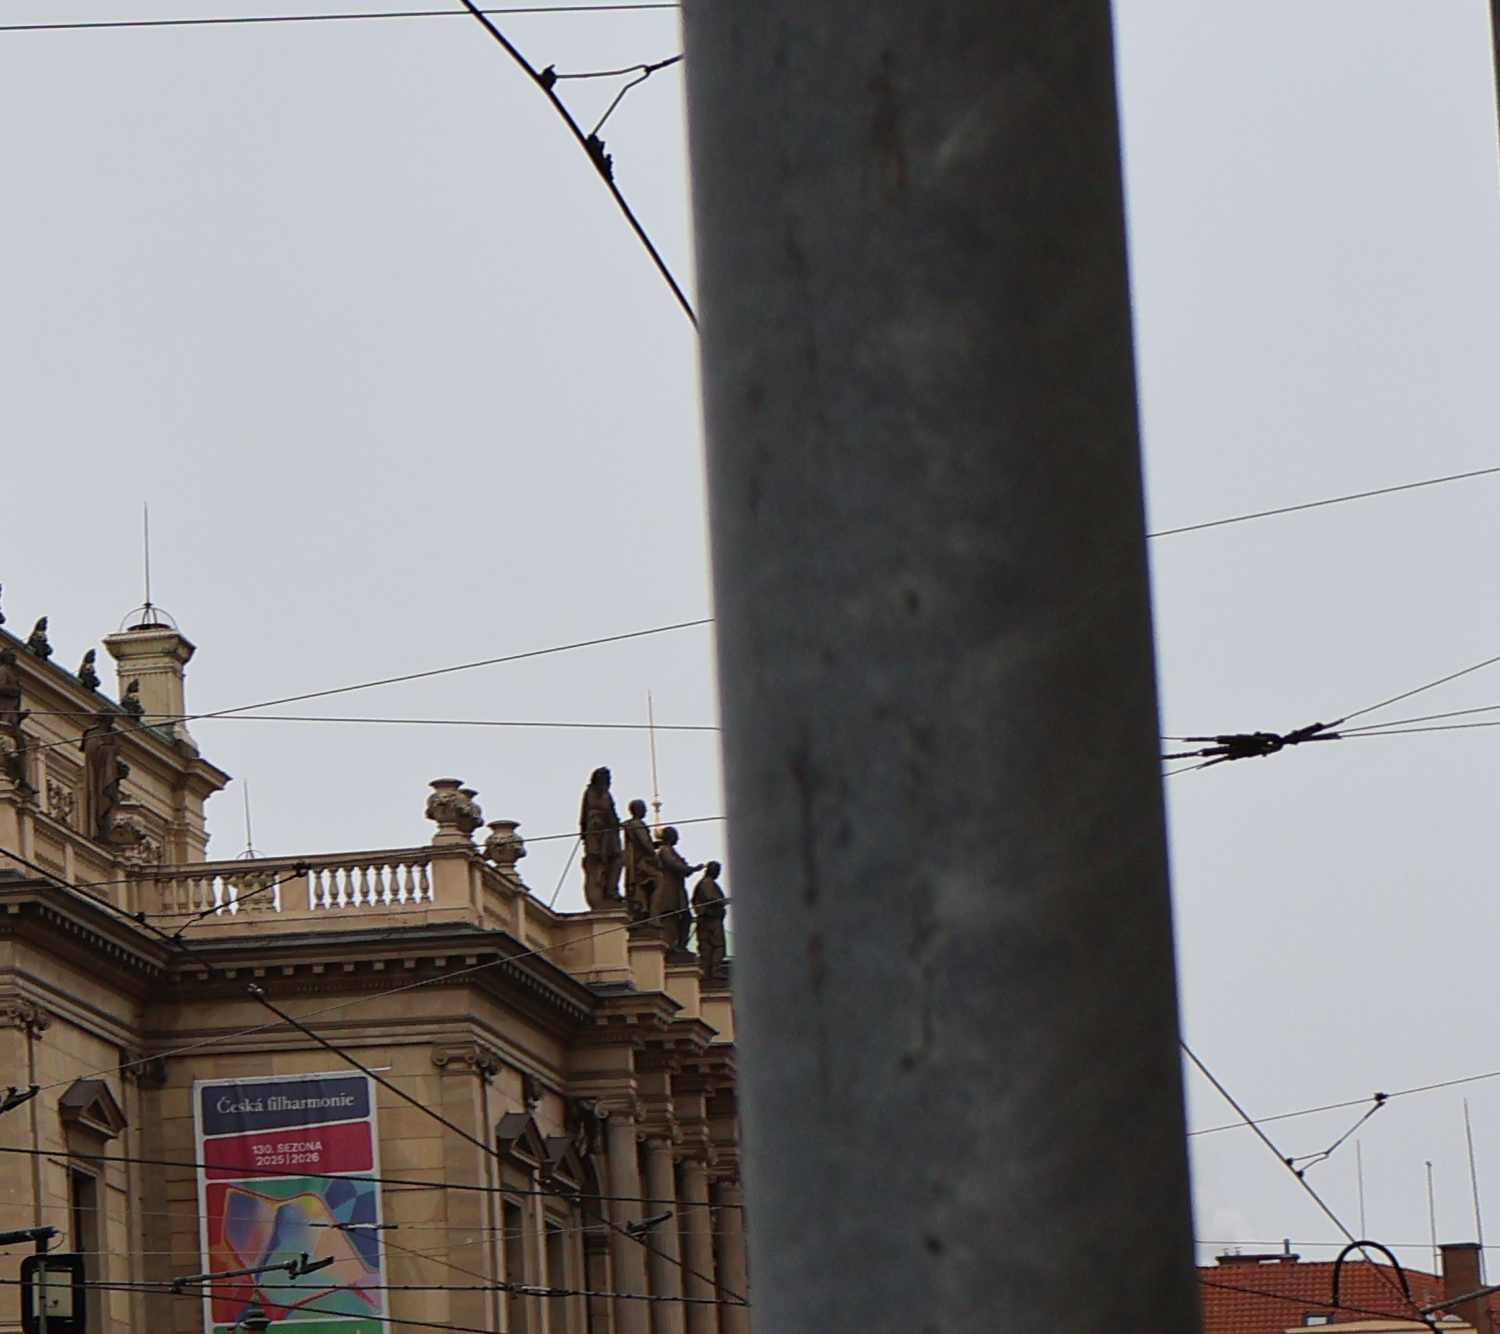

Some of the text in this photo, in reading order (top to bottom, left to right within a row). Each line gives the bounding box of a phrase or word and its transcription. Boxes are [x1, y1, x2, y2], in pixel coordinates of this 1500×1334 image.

[216, 1092, 355, 1115] Česká filharmonie
[252, 1141, 323, 1154] 130. SEZONA
